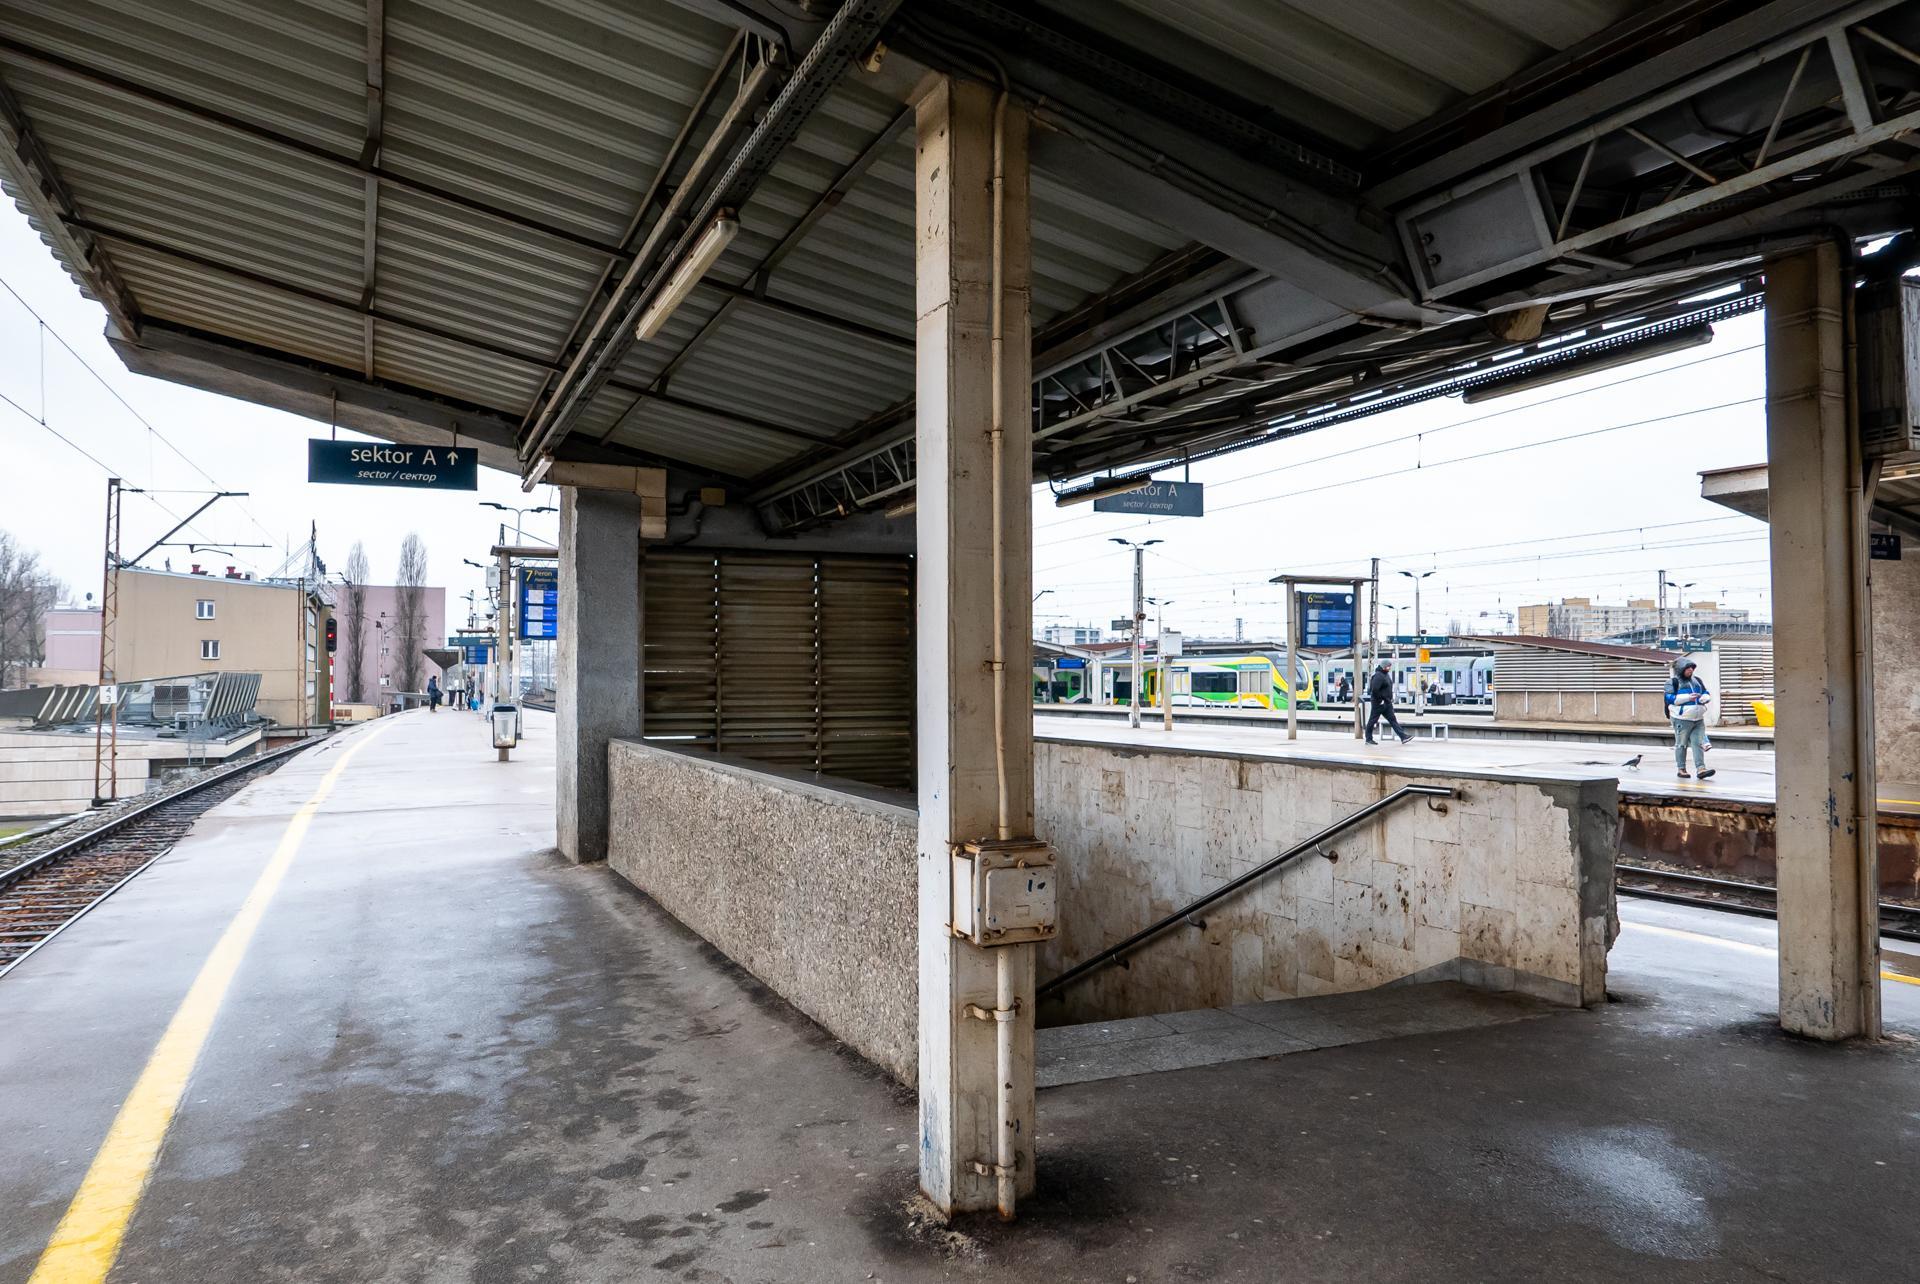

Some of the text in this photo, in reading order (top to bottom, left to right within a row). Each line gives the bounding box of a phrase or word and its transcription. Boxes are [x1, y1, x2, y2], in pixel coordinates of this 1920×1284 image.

[351, 446, 436, 465] sektor A
[358, 470, 391, 479] sector
[1168, 484, 1177, 497] A
[526, 570, 533, 582] 7
[1308, 594, 1313, 604] 6
